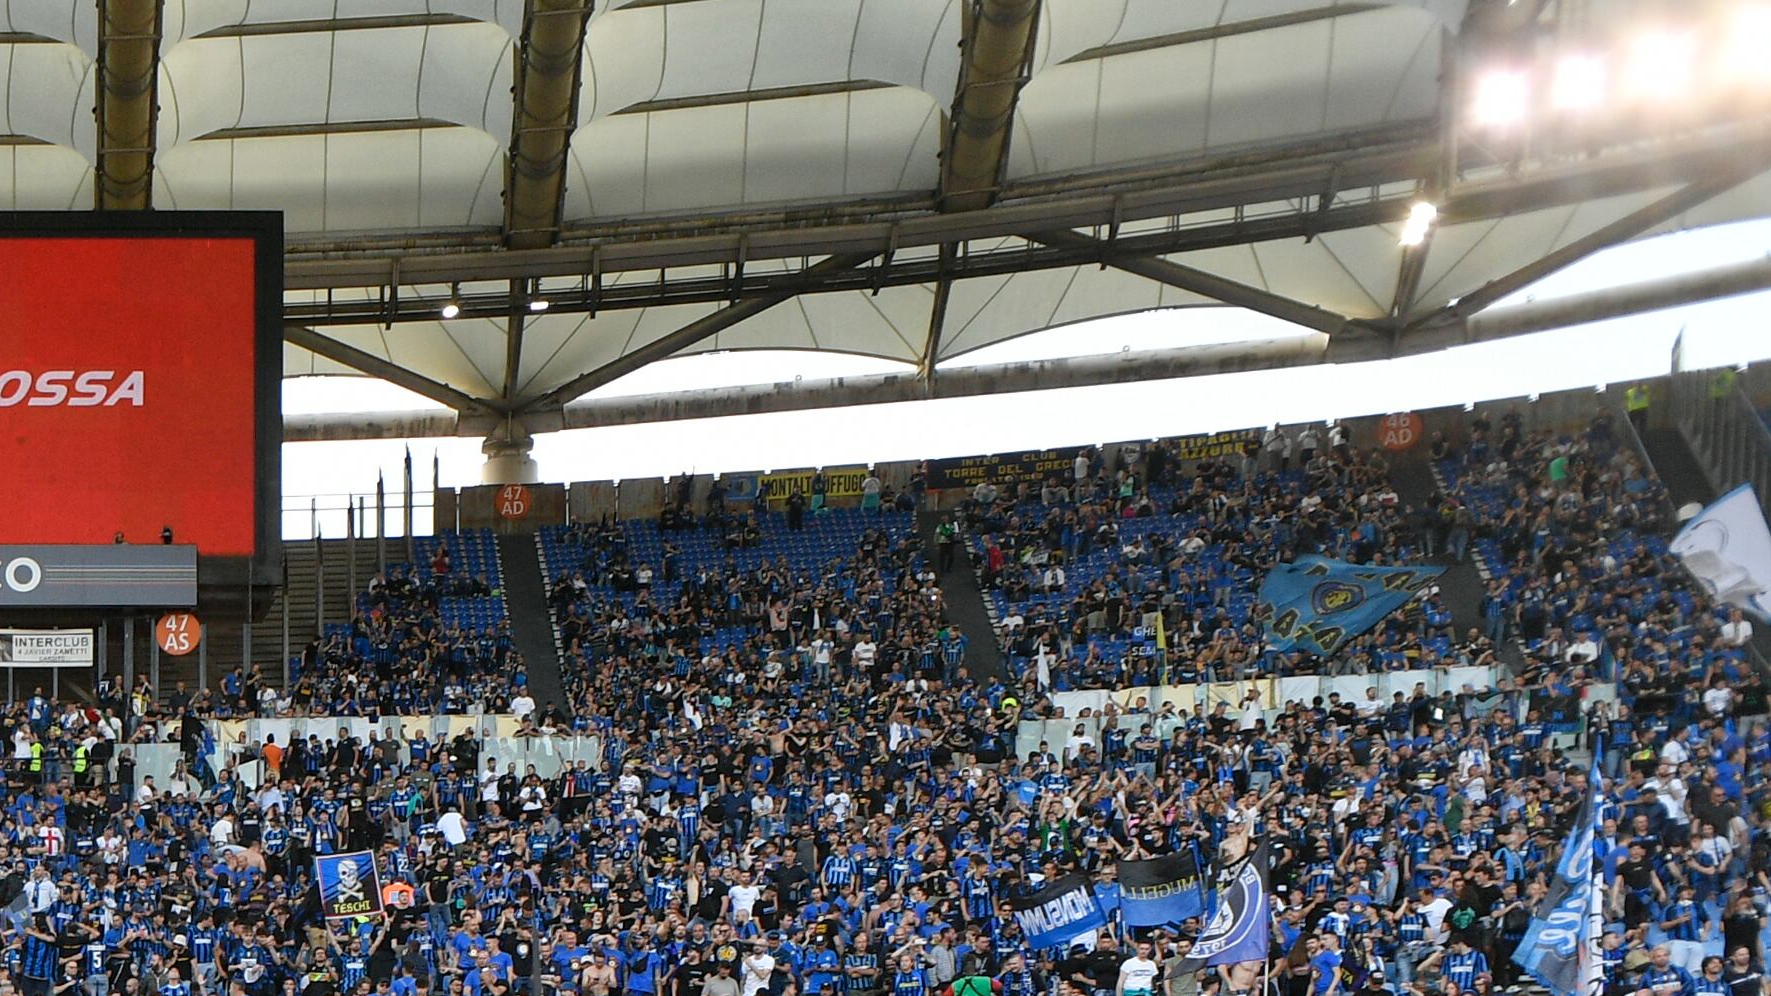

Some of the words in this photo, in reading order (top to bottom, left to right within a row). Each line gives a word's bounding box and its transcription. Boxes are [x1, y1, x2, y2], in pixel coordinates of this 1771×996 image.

[1384, 428, 1413, 446] AD
[1022, 451, 1058, 462] CLUB
[944, 466, 987, 479] TORRE
[998, 464, 1024, 475] DEL
[503, 486, 523, 500] 47
[761, 474, 814, 496] MONTALT
[501, 501, 524, 515] AD
[165, 614, 189, 632] 47
[164, 633, 190, 650] AS
[333, 899, 371, 915] TESCHI
[93, 951, 101, 968] 5
